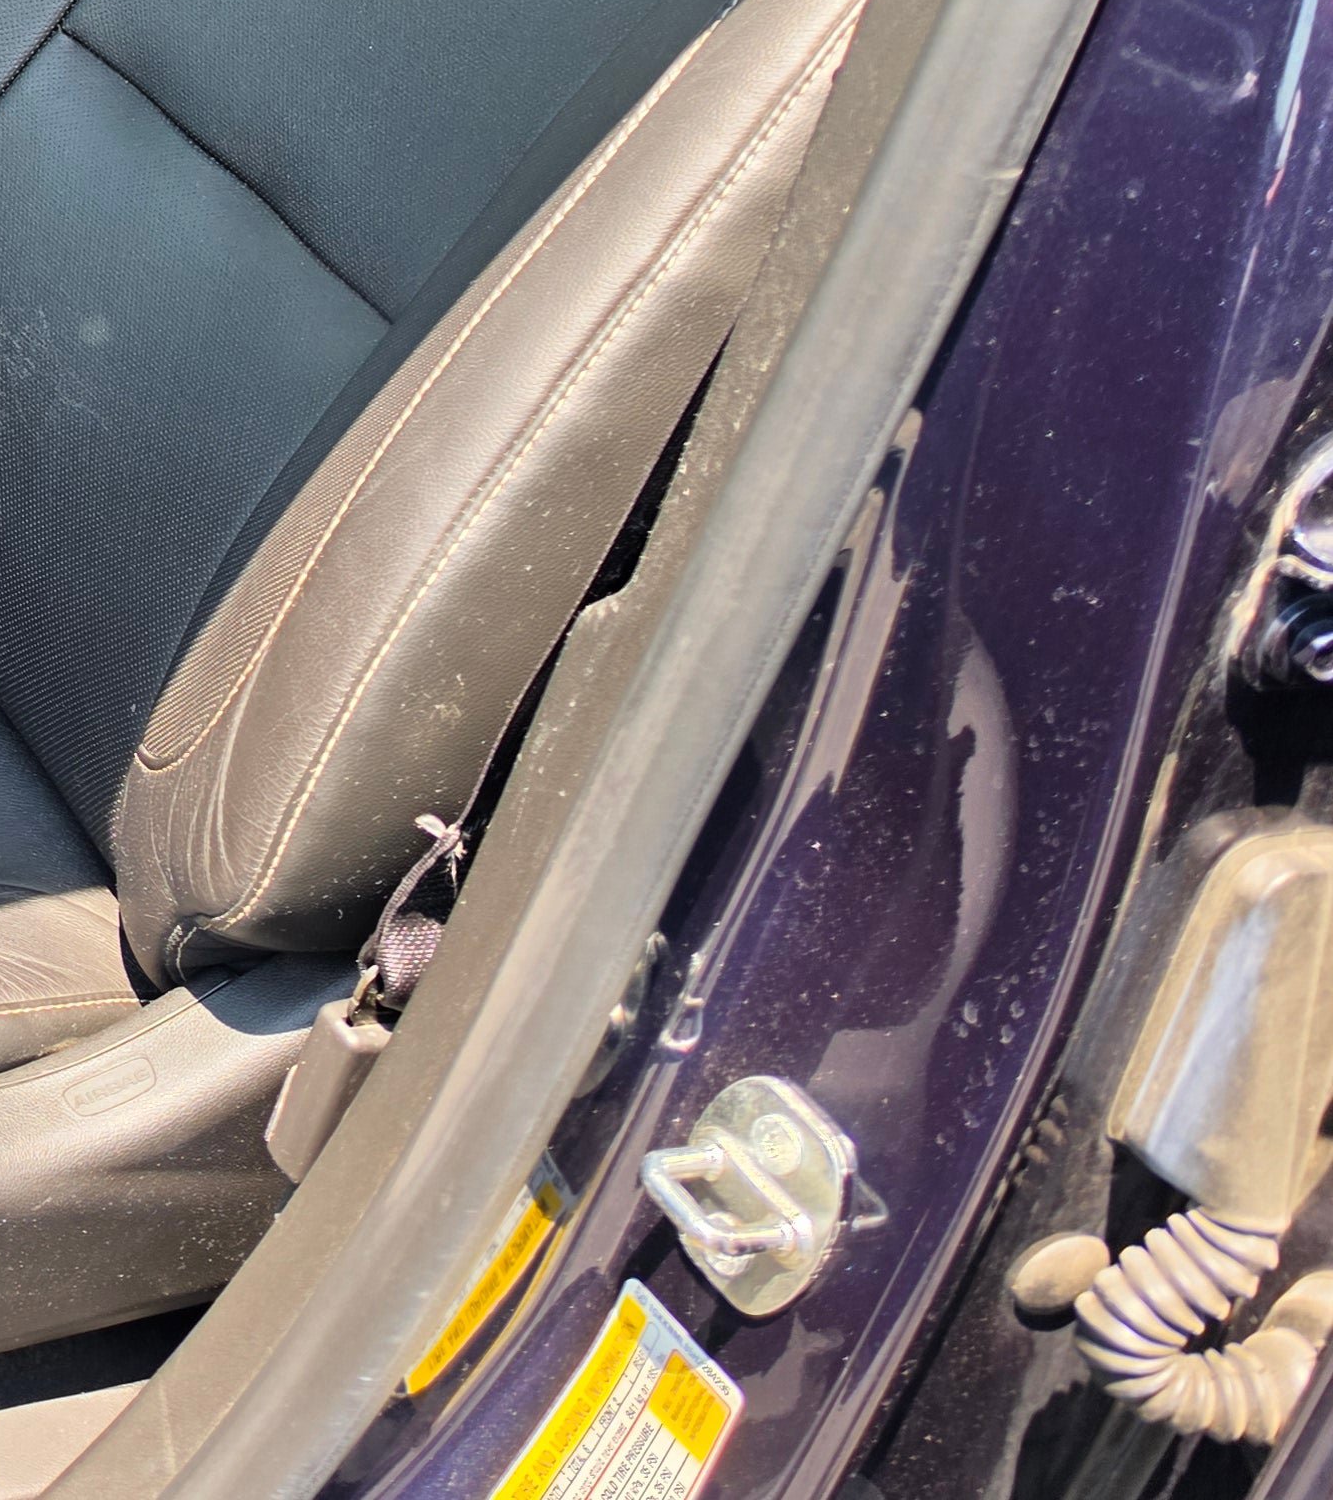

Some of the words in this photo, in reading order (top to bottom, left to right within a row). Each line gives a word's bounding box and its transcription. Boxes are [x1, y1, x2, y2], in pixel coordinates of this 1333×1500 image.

[74, 1069, 151, 1109] AIRBAG
[613, 1461, 630, 1483] TIRE
[625, 1422, 654, 1465] PRESSURE
